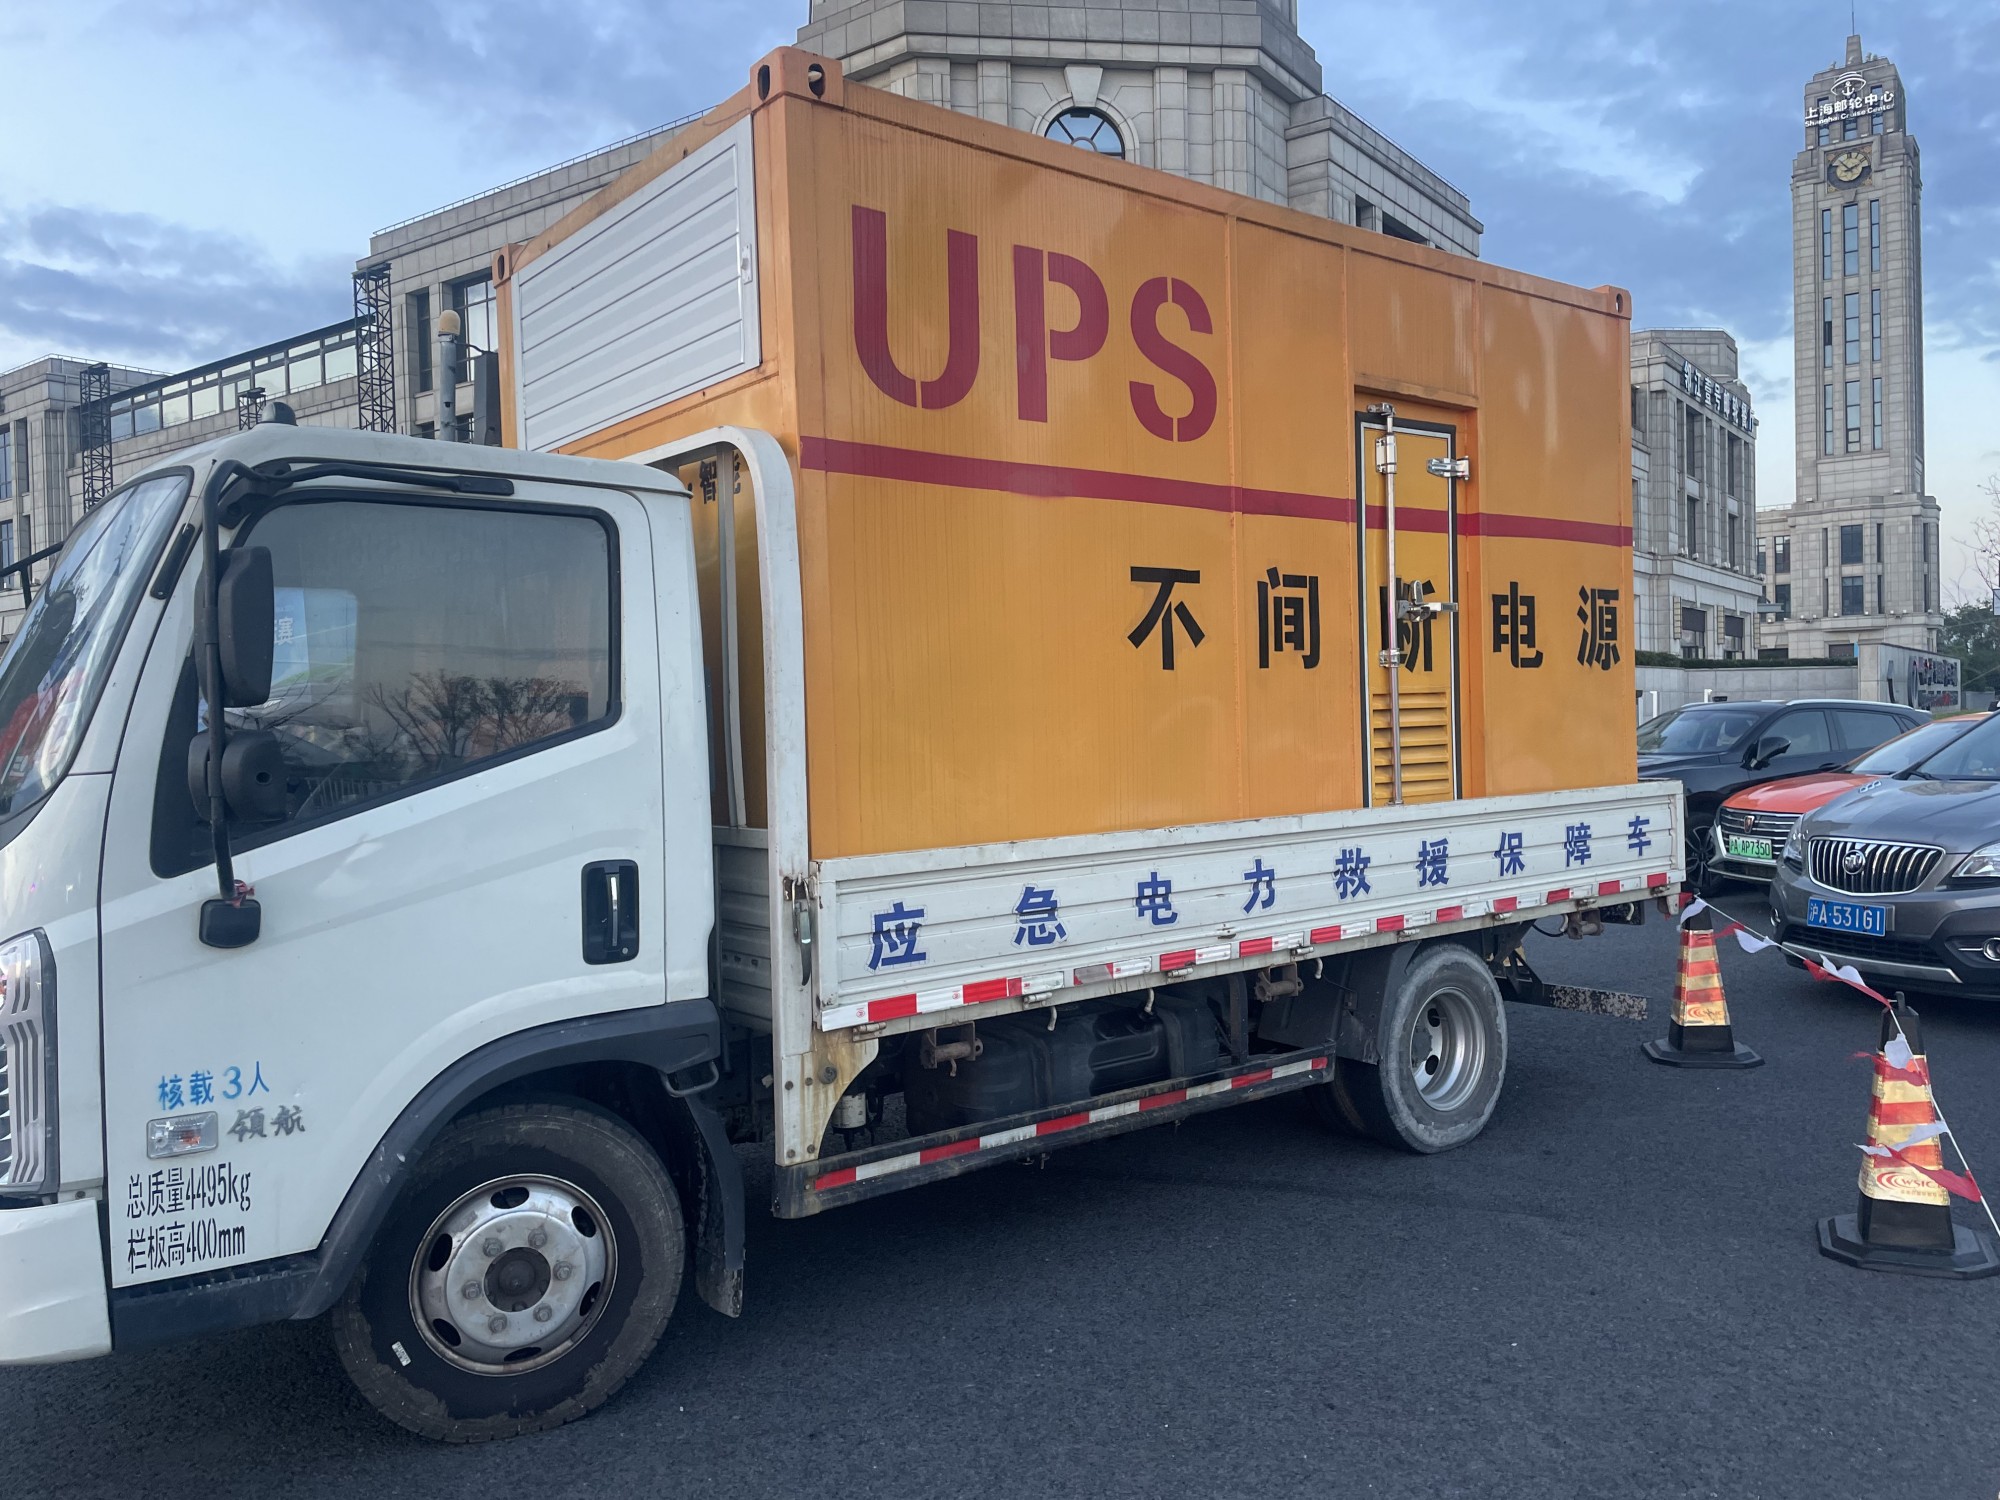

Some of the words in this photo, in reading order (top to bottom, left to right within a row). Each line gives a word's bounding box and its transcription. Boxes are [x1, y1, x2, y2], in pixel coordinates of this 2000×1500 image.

[1805, 91, 1895, 119] 上海邮轮中心
[852, 204, 1217, 442] UPS
[1127, 566, 1620, 673] 不间断电源
[1741, 840, 1770, 856] AP7350
[867, 815, 1652, 971] 应急电力救援保障车
[157, 1060, 270, 1111] 核载3人
[126, 1161, 252, 1219] 总质量4495kg
[127, 1217, 247, 1275] 栏板高400mm
